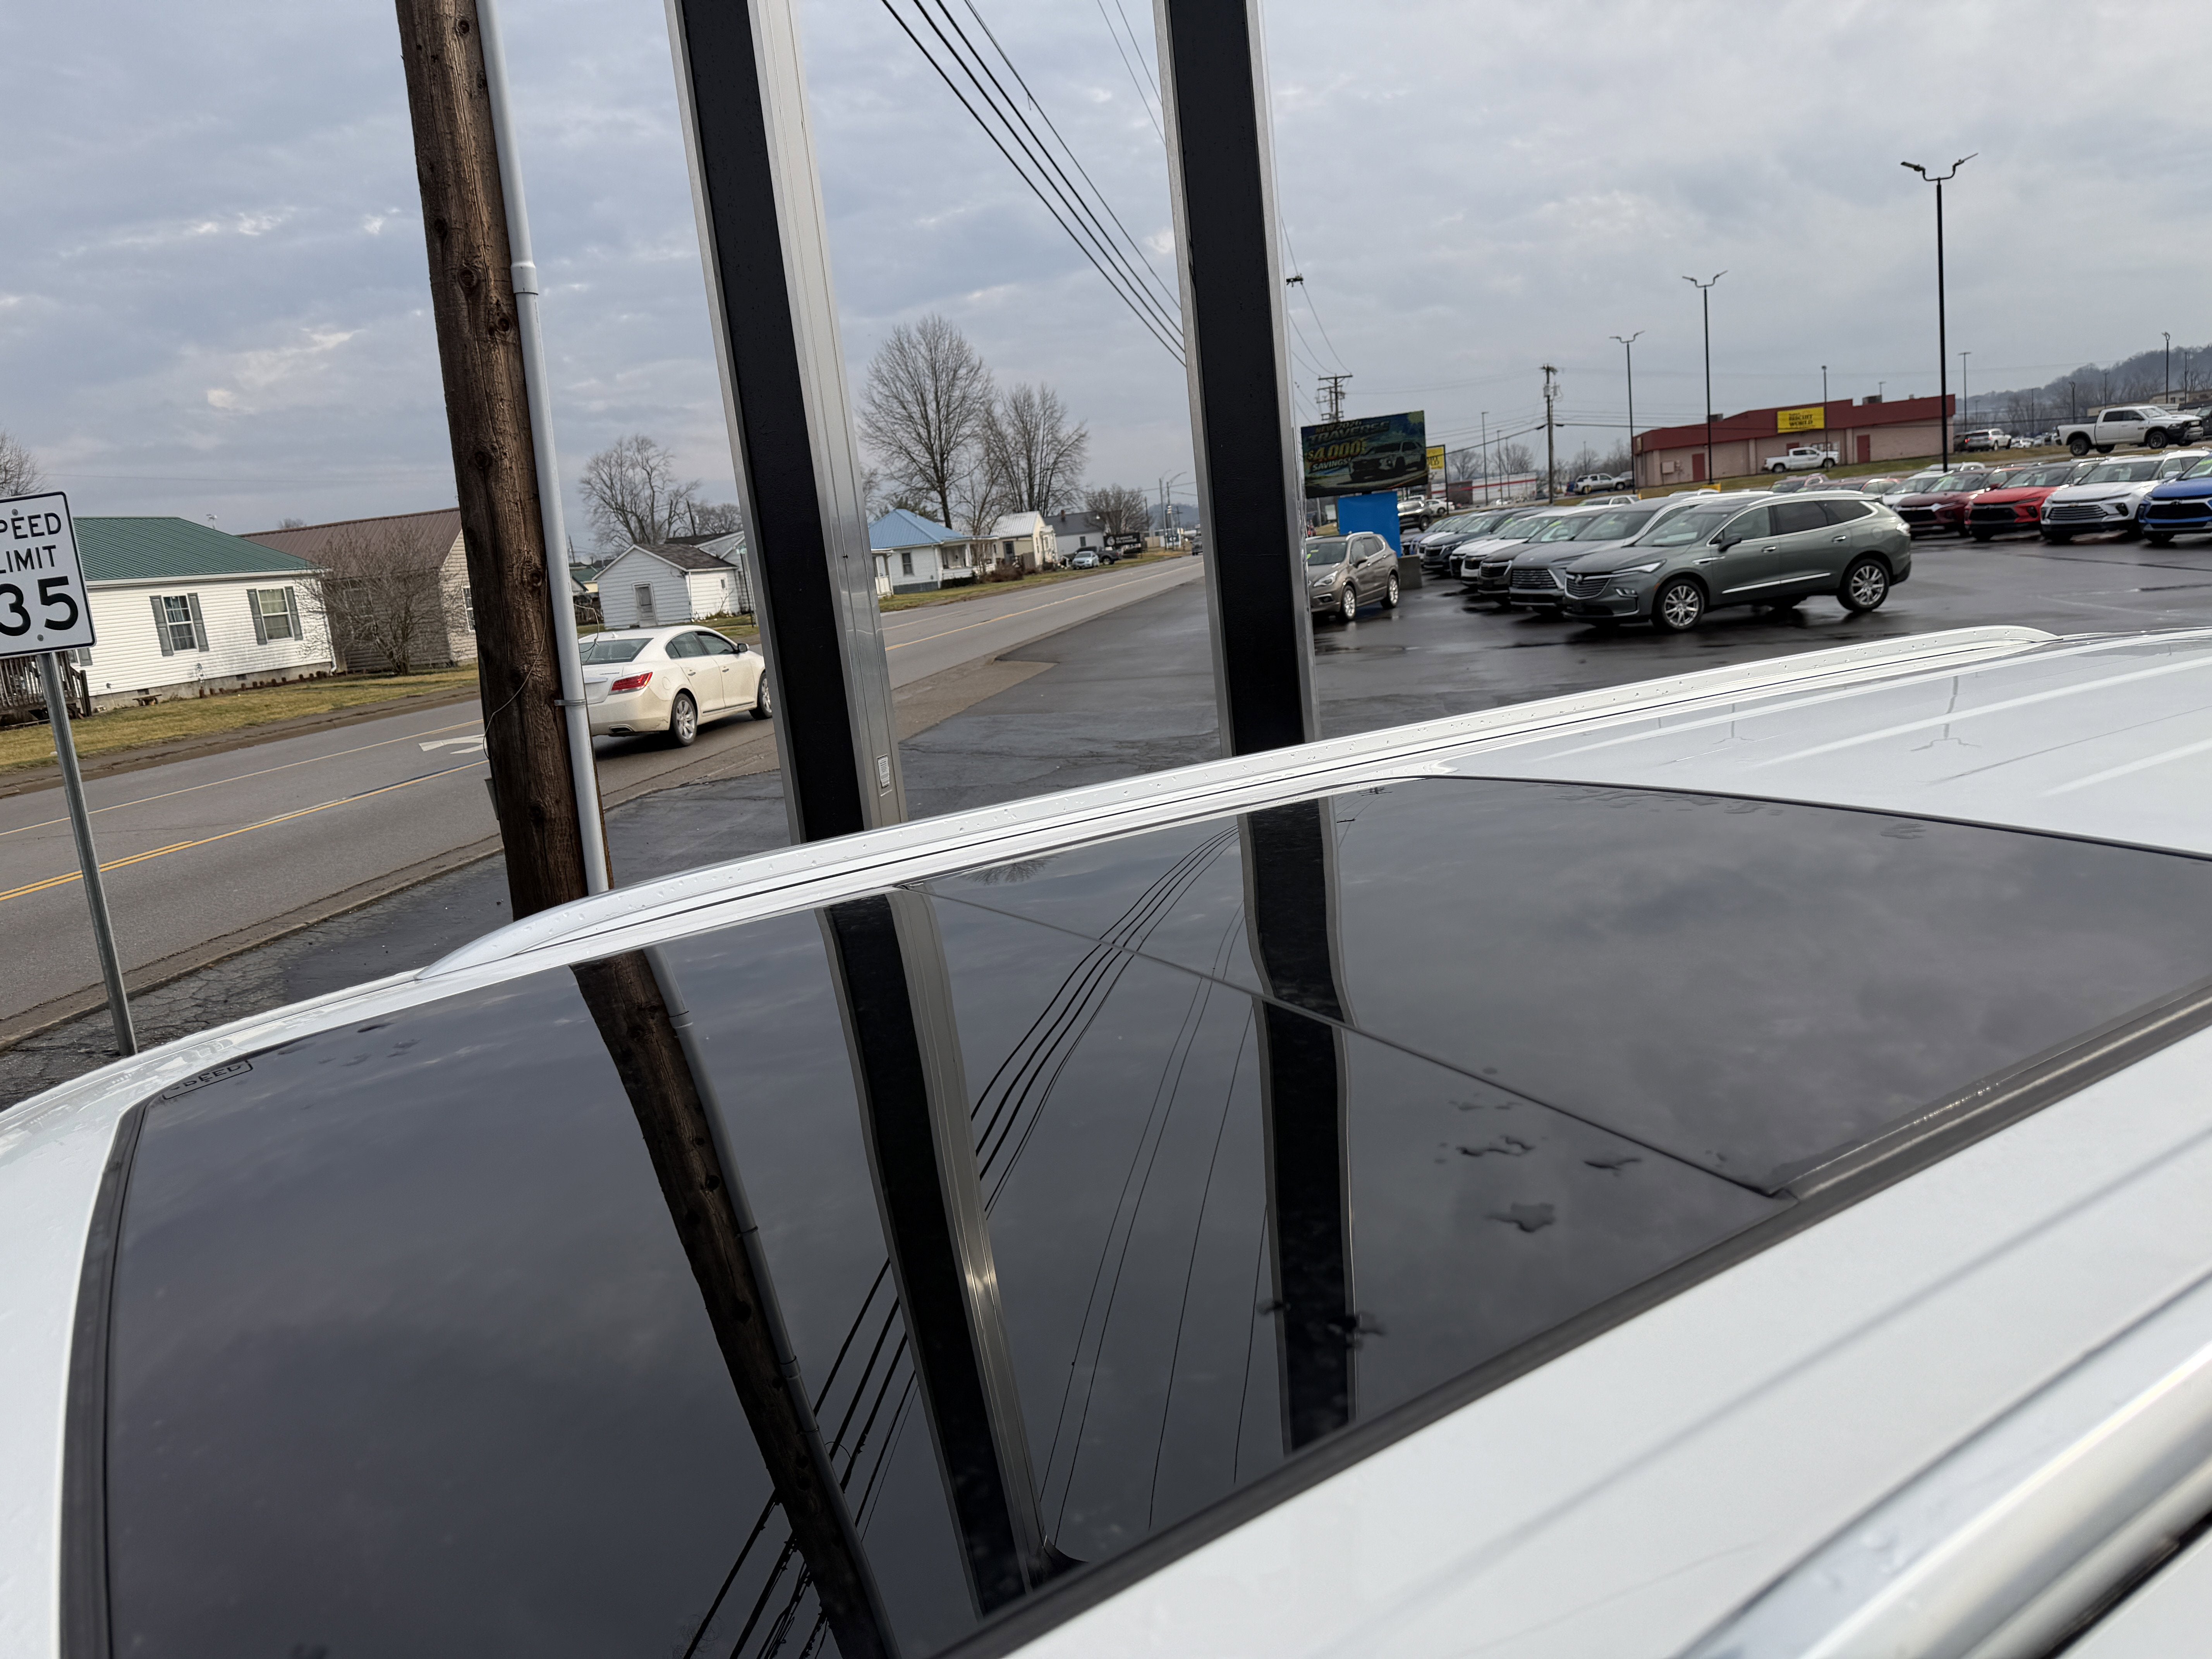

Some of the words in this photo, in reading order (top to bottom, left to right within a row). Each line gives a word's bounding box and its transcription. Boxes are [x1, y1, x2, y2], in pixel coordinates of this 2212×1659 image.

[1307, 420, 1391, 444] TRAVERSE
[0, 544, 56, 574] IMIT
[0, 576, 78, 636] 35
